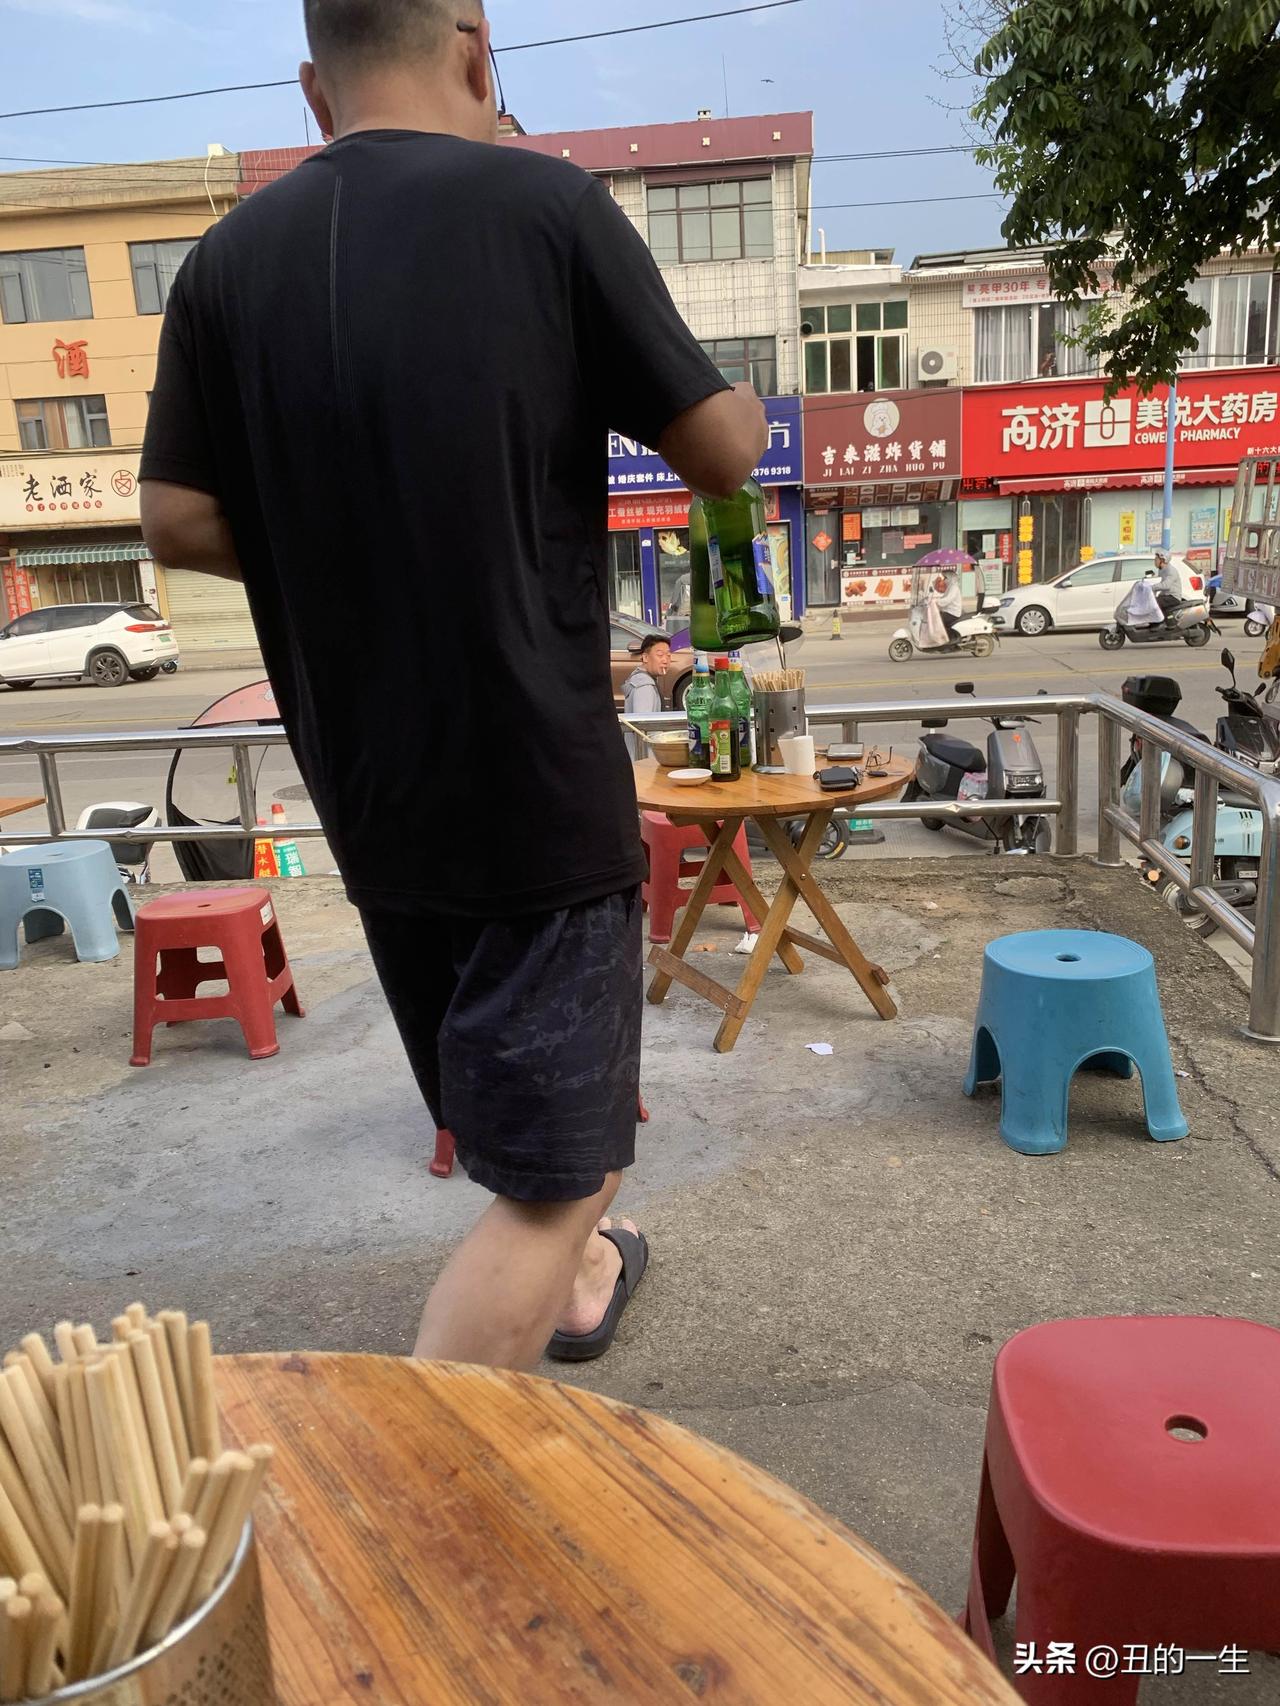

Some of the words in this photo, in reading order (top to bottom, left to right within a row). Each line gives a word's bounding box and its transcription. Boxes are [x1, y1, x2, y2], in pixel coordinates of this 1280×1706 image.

[52, 338, 89, 379] 酒
[1001, 403, 1080, 452] 高济
[1135, 431, 1177, 444] COWE
[1180, 427, 1241, 442] PHARMACY
[751, 467, 769, 477] 376
[770, 466, 791, 475] 9318
[822, 468, 832, 477] JI
[840, 467, 854, 476] LAI
[862, 466, 872, 474] ZI
[879, 465, 898, 473] ZHA
[905, 463, 925, 471] HUO
[932, 462, 945, 470] PU
